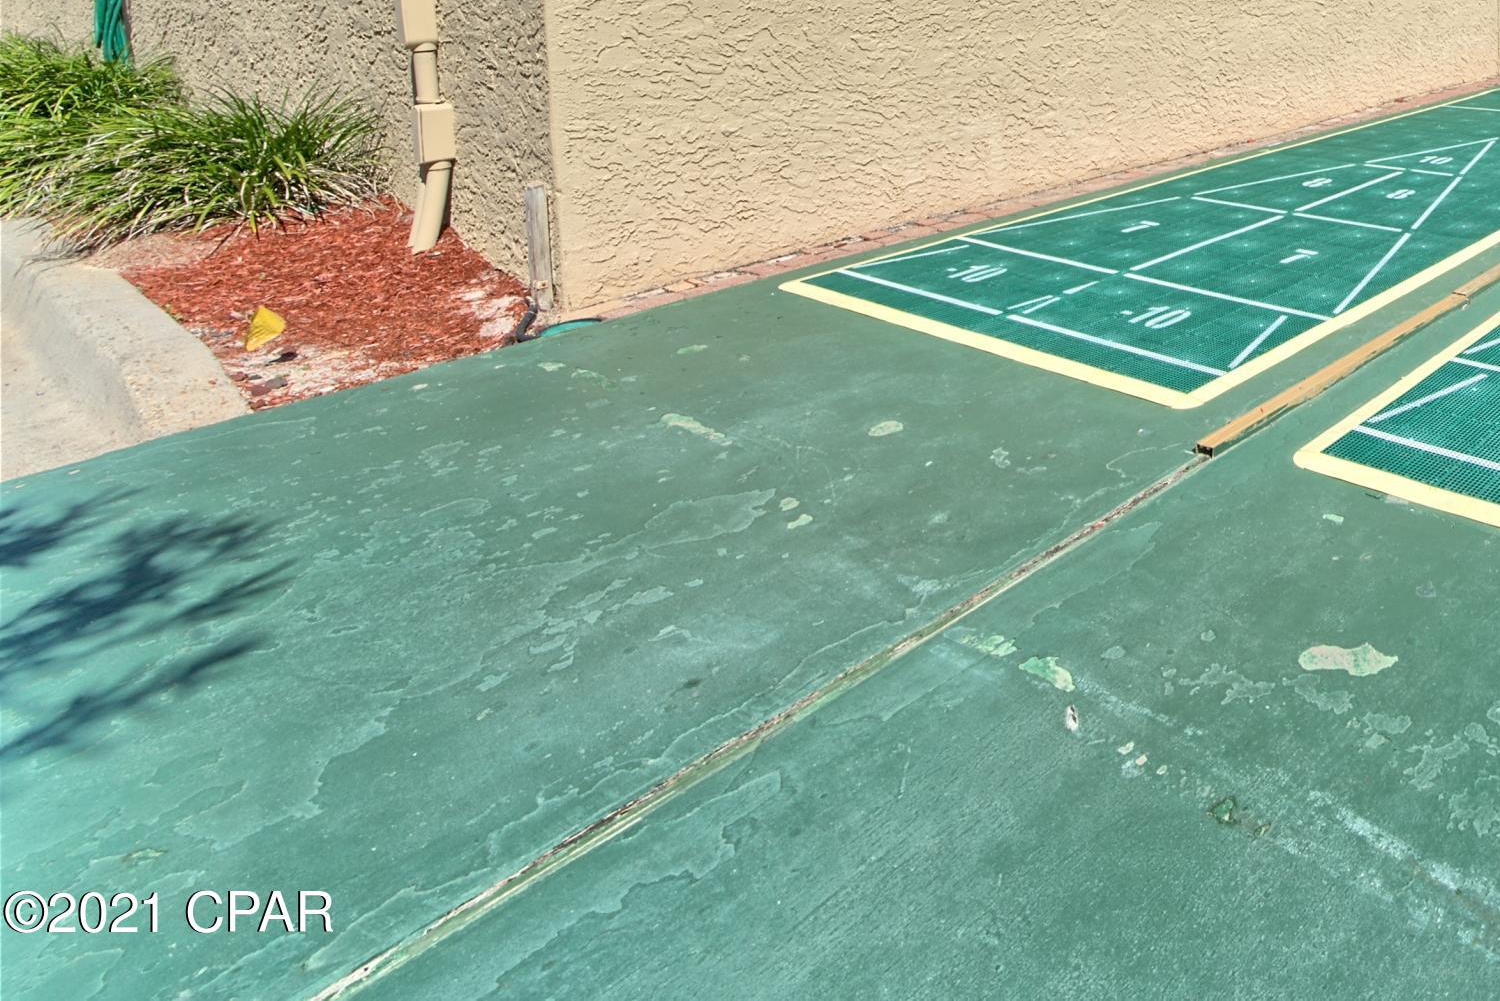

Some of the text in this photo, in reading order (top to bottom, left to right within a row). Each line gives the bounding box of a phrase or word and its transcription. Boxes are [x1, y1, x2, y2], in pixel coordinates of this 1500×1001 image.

[1418, 155, 1454, 165] 10
[1302, 177, 1333, 188] 8
[1386, 188, 1416, 199] 8
